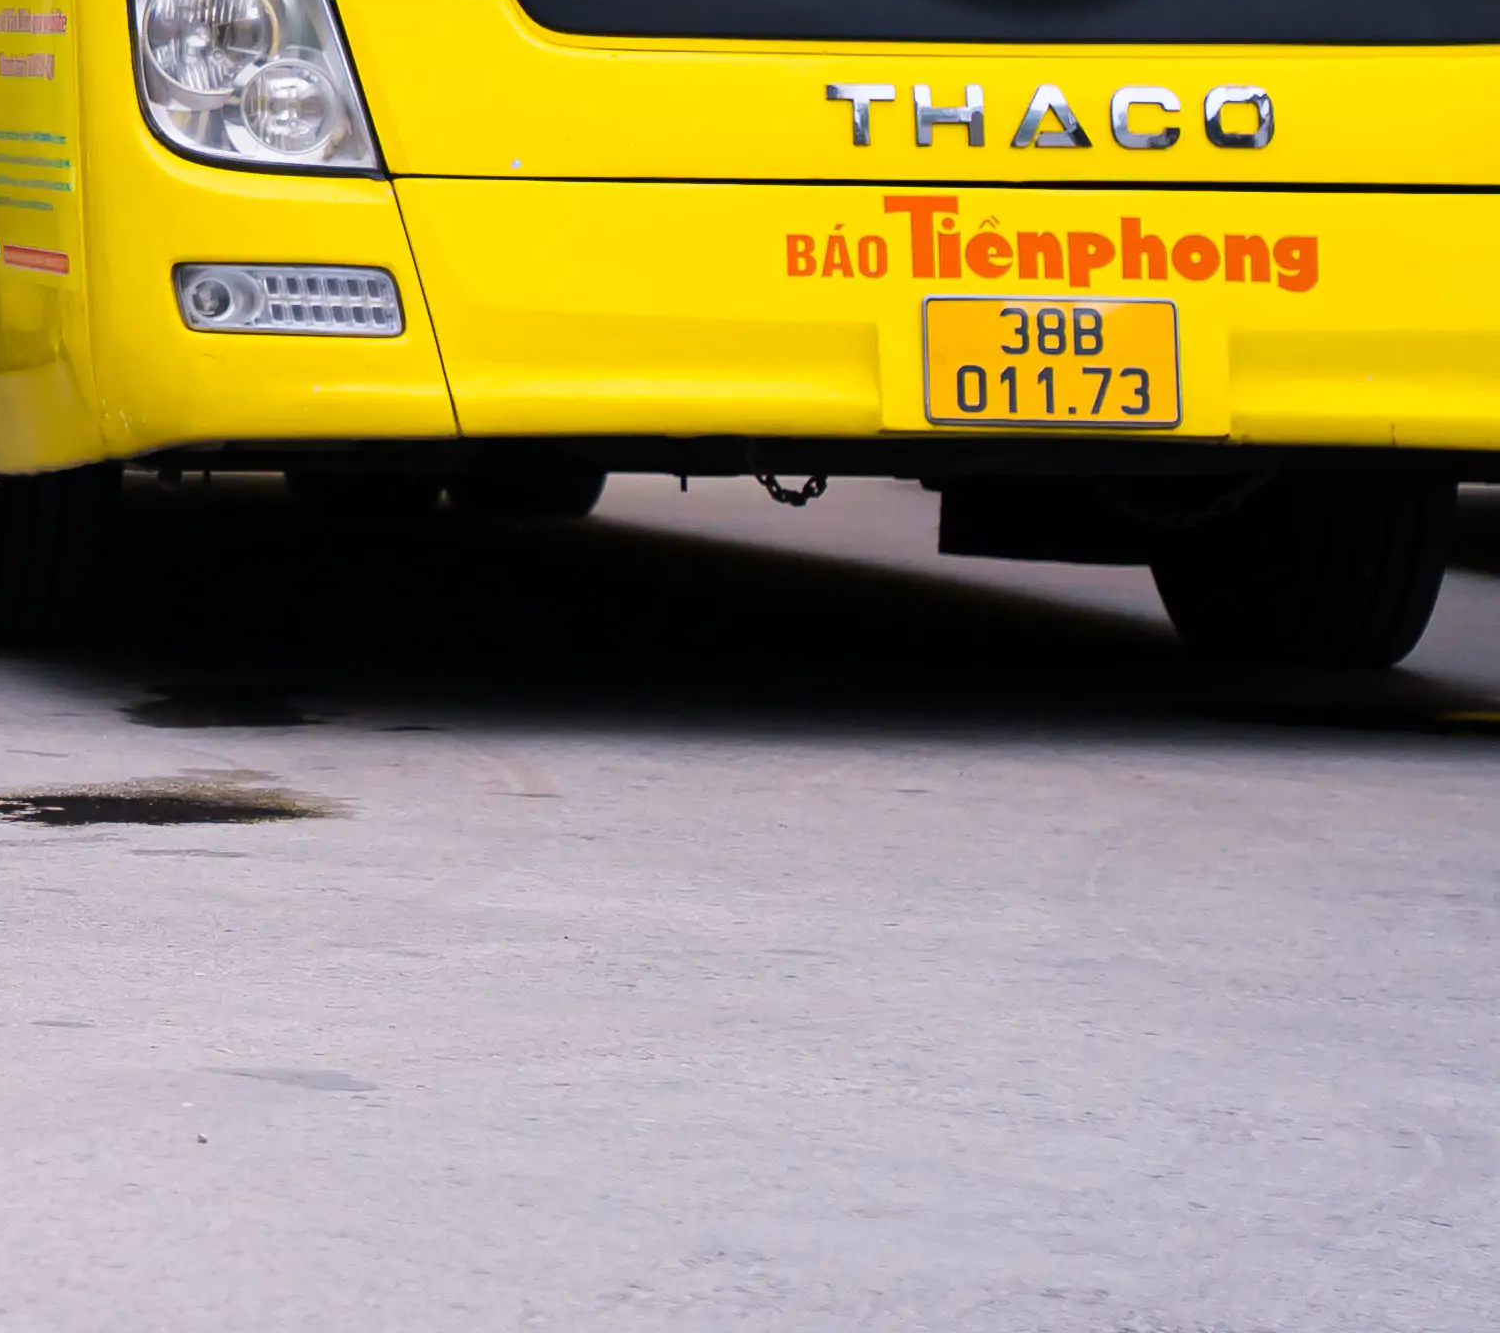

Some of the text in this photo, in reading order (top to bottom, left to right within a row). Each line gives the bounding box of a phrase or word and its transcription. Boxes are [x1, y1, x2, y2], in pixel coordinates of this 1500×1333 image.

[826, 83, 1276, 150] THACO
[785, 223, 889, 279] BÁO
[999, 307, 1105, 357] 38B
[956, 365, 1152, 417] 011.73
